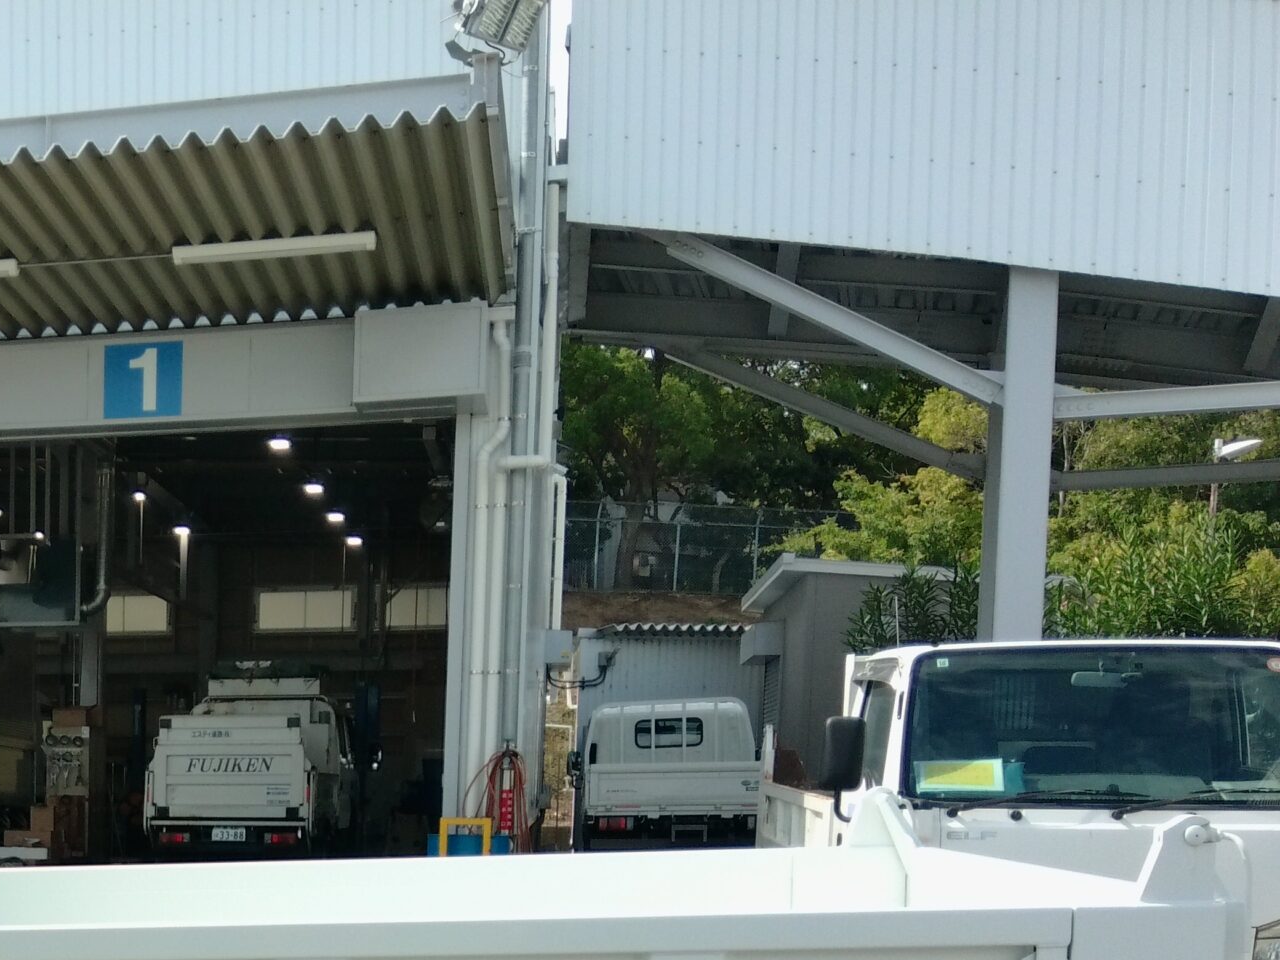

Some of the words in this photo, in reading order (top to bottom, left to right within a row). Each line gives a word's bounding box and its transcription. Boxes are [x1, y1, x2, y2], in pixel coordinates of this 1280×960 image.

[128, 347, 158, 412] 1
[185, 756, 275, 774] FUJIKEN
[946, 830, 999, 842] ELF
